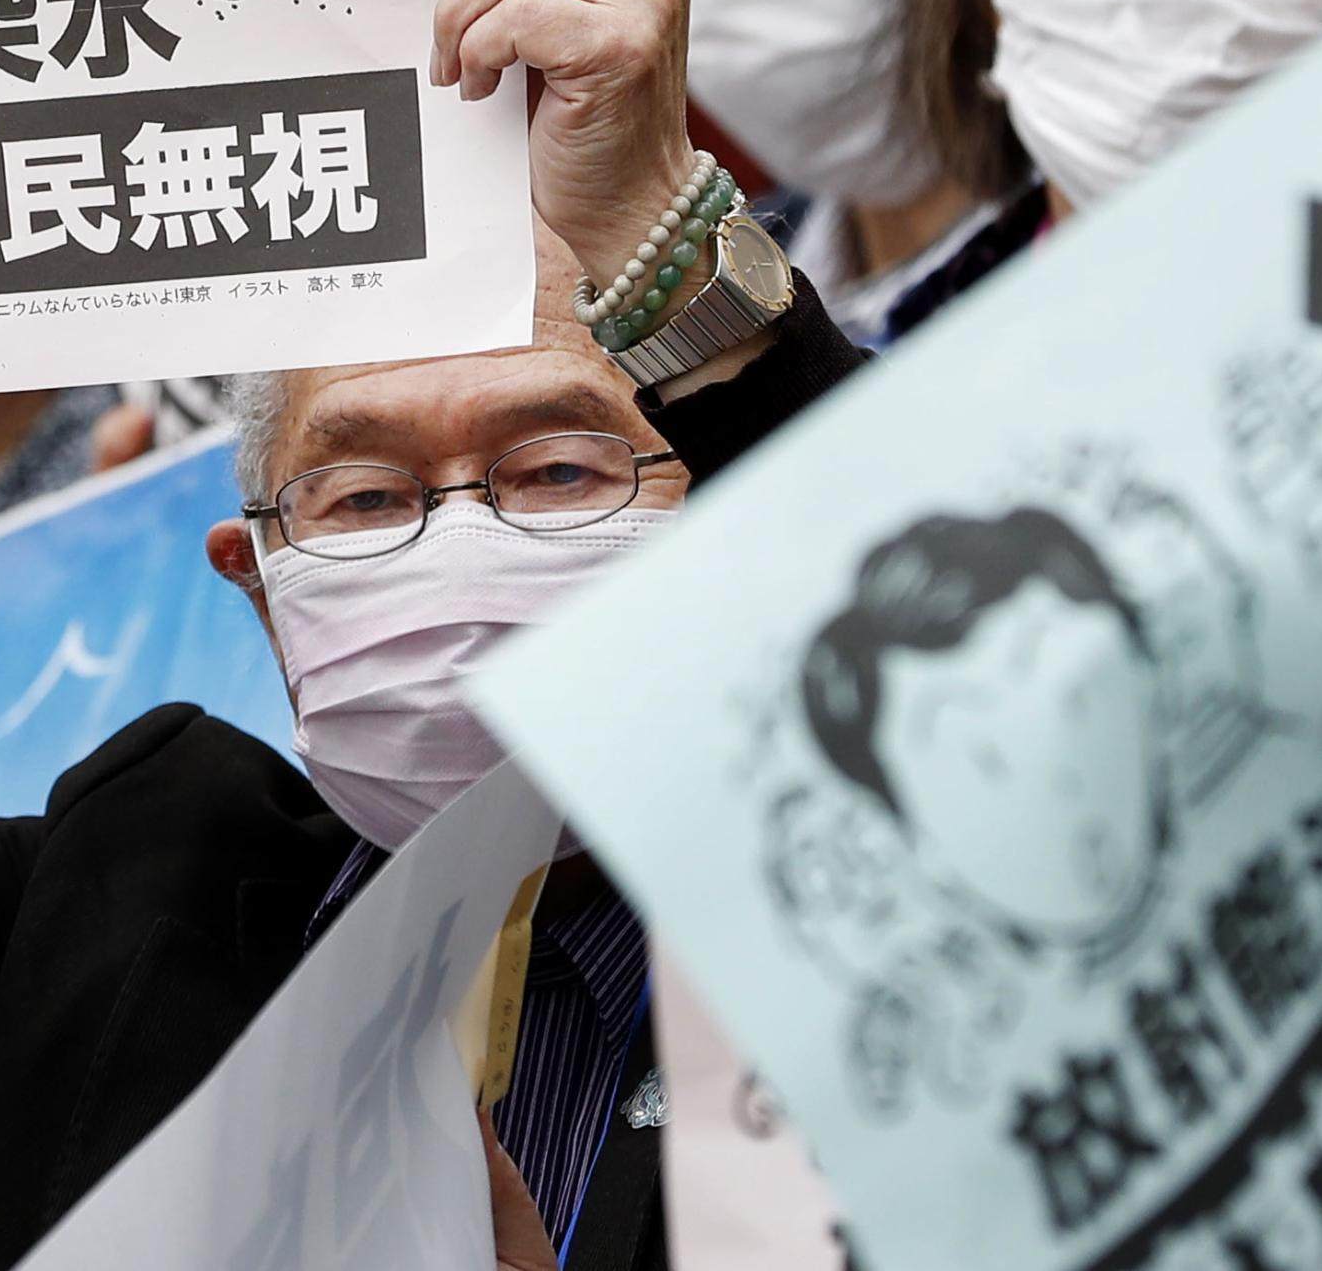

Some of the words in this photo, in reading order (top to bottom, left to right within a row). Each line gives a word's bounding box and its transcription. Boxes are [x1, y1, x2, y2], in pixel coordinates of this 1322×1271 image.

[228, 279, 290, 299] イラスト
[351, 271, 384, 290] 章次
